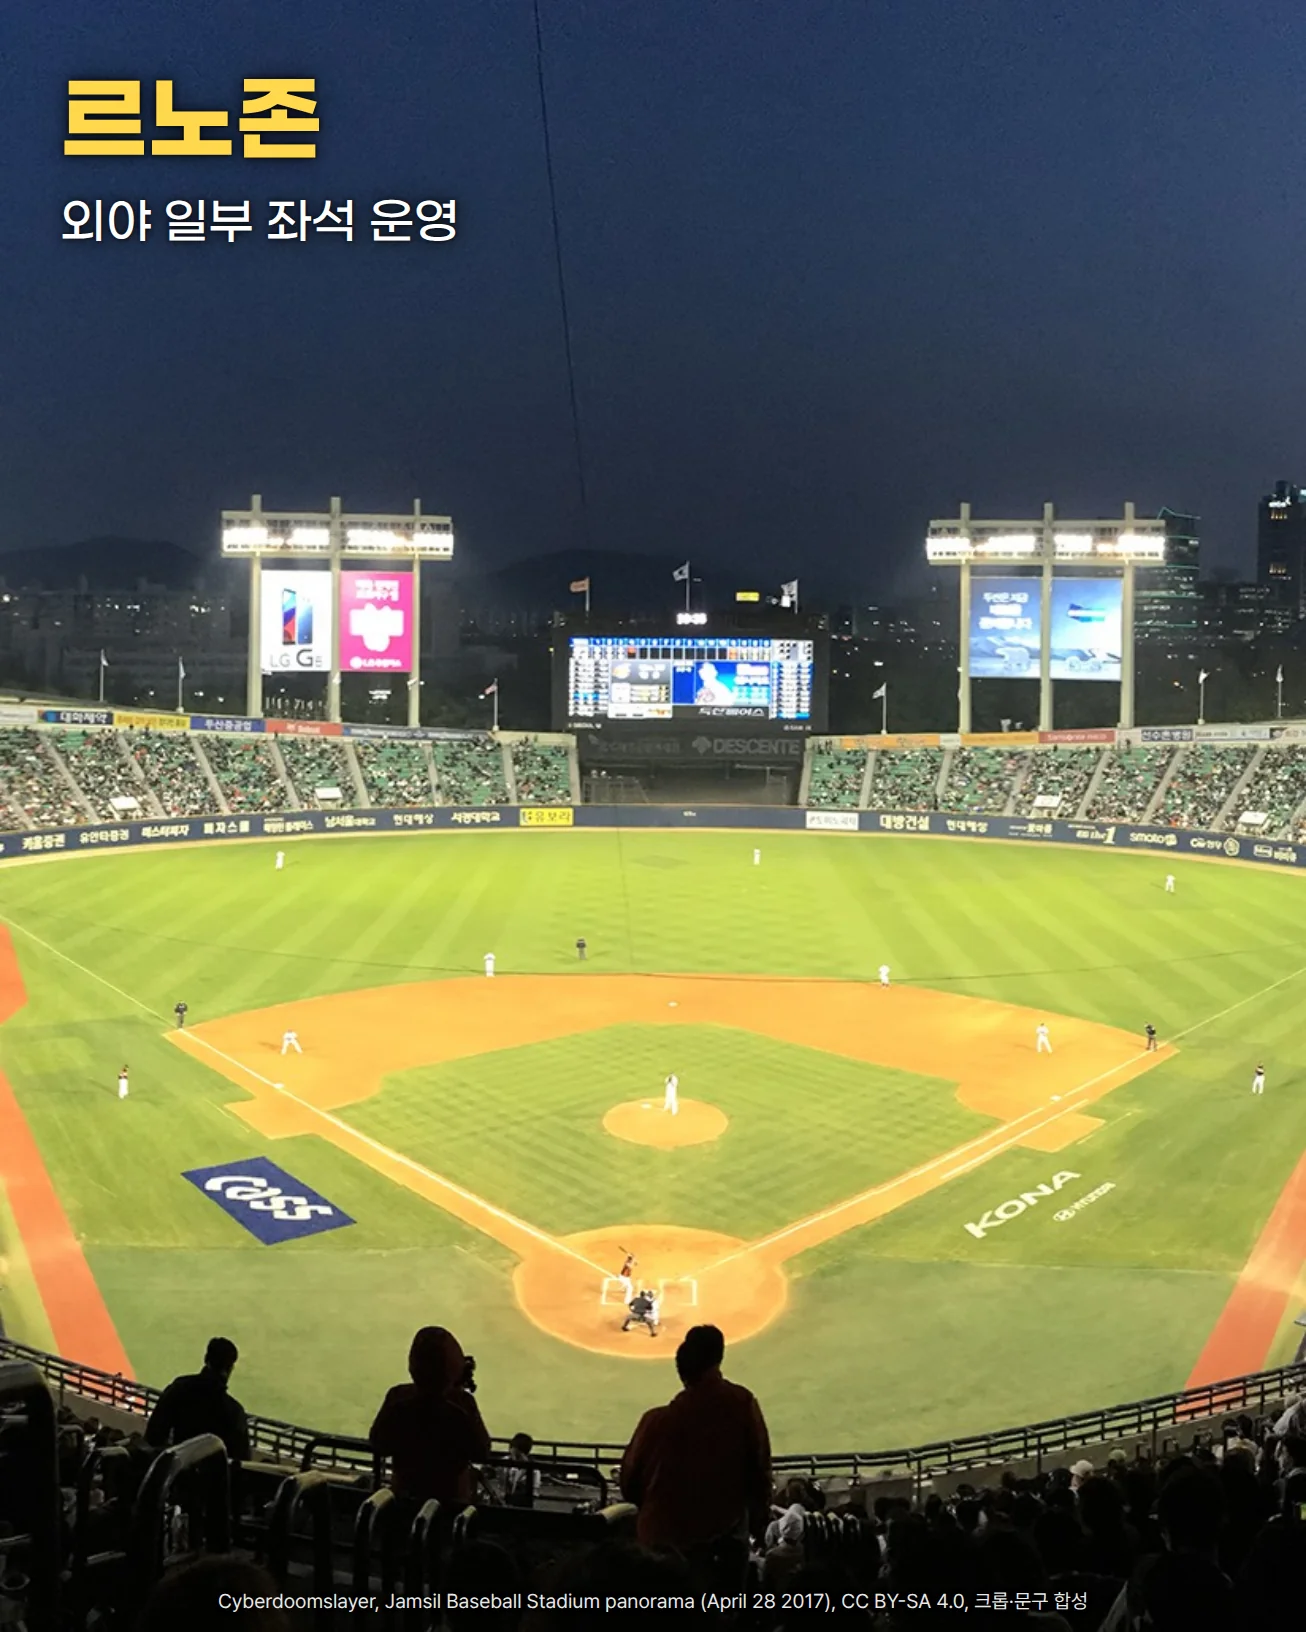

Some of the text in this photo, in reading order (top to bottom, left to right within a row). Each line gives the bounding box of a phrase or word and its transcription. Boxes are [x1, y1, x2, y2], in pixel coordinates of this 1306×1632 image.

[270, 652, 290, 667] LG
[60, 711, 107, 723] 대화제약
[699, 708, 764, 717] 두산베어스
[205, 719, 252, 731] 두산중공업
[713, 738, 801, 755] DESCENTE
[392, 813, 434, 826] 현대해상
[535, 811, 571, 822] 유보라
[880, 814, 930, 831] 대방건설
[946, 819, 989, 833] 현대해상
[79, 829, 130, 844] 유안타증권
[204, 1176, 333, 1221] Cass
[964, 1170, 1082, 1239] KONA
